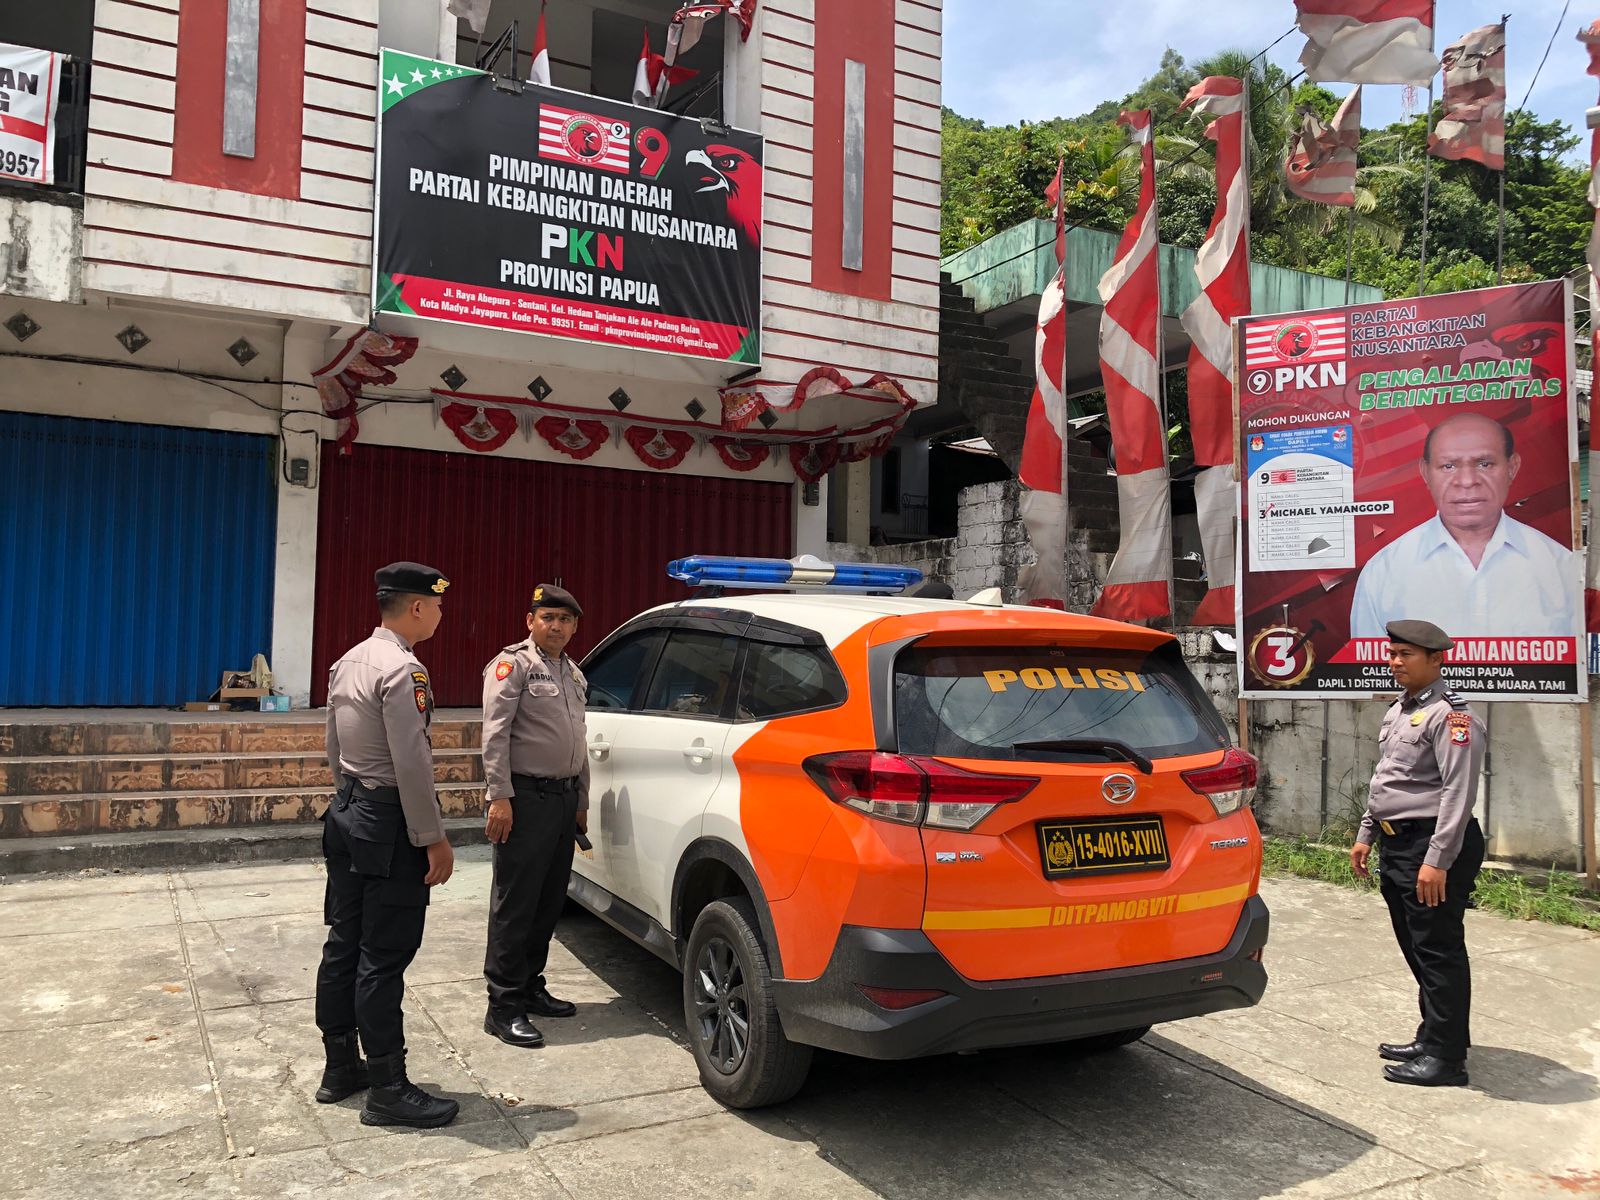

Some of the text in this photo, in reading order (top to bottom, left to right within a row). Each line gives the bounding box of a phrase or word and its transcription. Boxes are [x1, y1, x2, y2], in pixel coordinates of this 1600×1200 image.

[614, 125, 623, 136] 9
[634, 127, 672, 180] 9
[489, 154, 673, 211] PIMPINAN DAERAH
[409, 167, 738, 251] PARTAI KEBANGKITAN NUSANTARA
[541, 223, 624, 271] PKN
[500, 259, 660, 307] PROVINSI PAPUA
[420, 298, 440, 310] Kota
[441, 300, 469, 314] Madya
[470, 305, 510, 320] Jayapura.
[511, 311, 532, 323] Kode
[533, 315, 550, 326] Pos.
[578, 321, 600, 333] Email
[605, 326, 719, 350] pknprovinsipapua21@gmail.com
[443, 287, 454, 298] Jl.
[456, 289, 476, 302] Raya
[478, 292, 511, 307] Abepura
[517, 298, 550, 313] Sentani,
[551, 303, 566, 314] Kel.
[567, 306, 593, 319] Hedam
[594, 309, 627, 324] Tanjakan
[627, 315, 639, 326] Ale
[640, 317, 653, 328] Ale
[653, 319, 680, 333] Padang
[680, 323, 701, 335] Bulan
[1351, 305, 1417, 325] PARTAI
[1351, 313, 1486, 342] KEBANGKITAN
[1351, 333, 1467, 358] NUSANTARA
[1275, 361, 1346, 392] PKN
[1359, 357, 1533, 391] PENGALAMAN
[1359, 378, 1562, 411] BERINTEGRITAS
[1248, 410, 1350, 428] MOHON DUKUNGAN
[1260, 473, 1270, 484] 9
[1259, 503, 1390, 519] 3 MICHAEL YAMANGGOP
[1267, 637, 1296, 676] 3
[1477, 667, 1515, 677] PAPUA
[529, 673, 555, 682] ABDUL
[983, 667, 1146, 693] POLISI
[1317, 678, 1347, 688] DAPIL
[1347, 678, 1353, 688] 1
[1354, 678, 1392, 688] DISTRIK
[1487, 679, 1495, 690] &
[1497, 680, 1537, 690] MUARA
[1538, 680, 1566, 691] TAMI
[1077, 829, 1162, 860] 15-4016-XVII
[1052, 895, 1179, 926] DITPAMOBVIT
